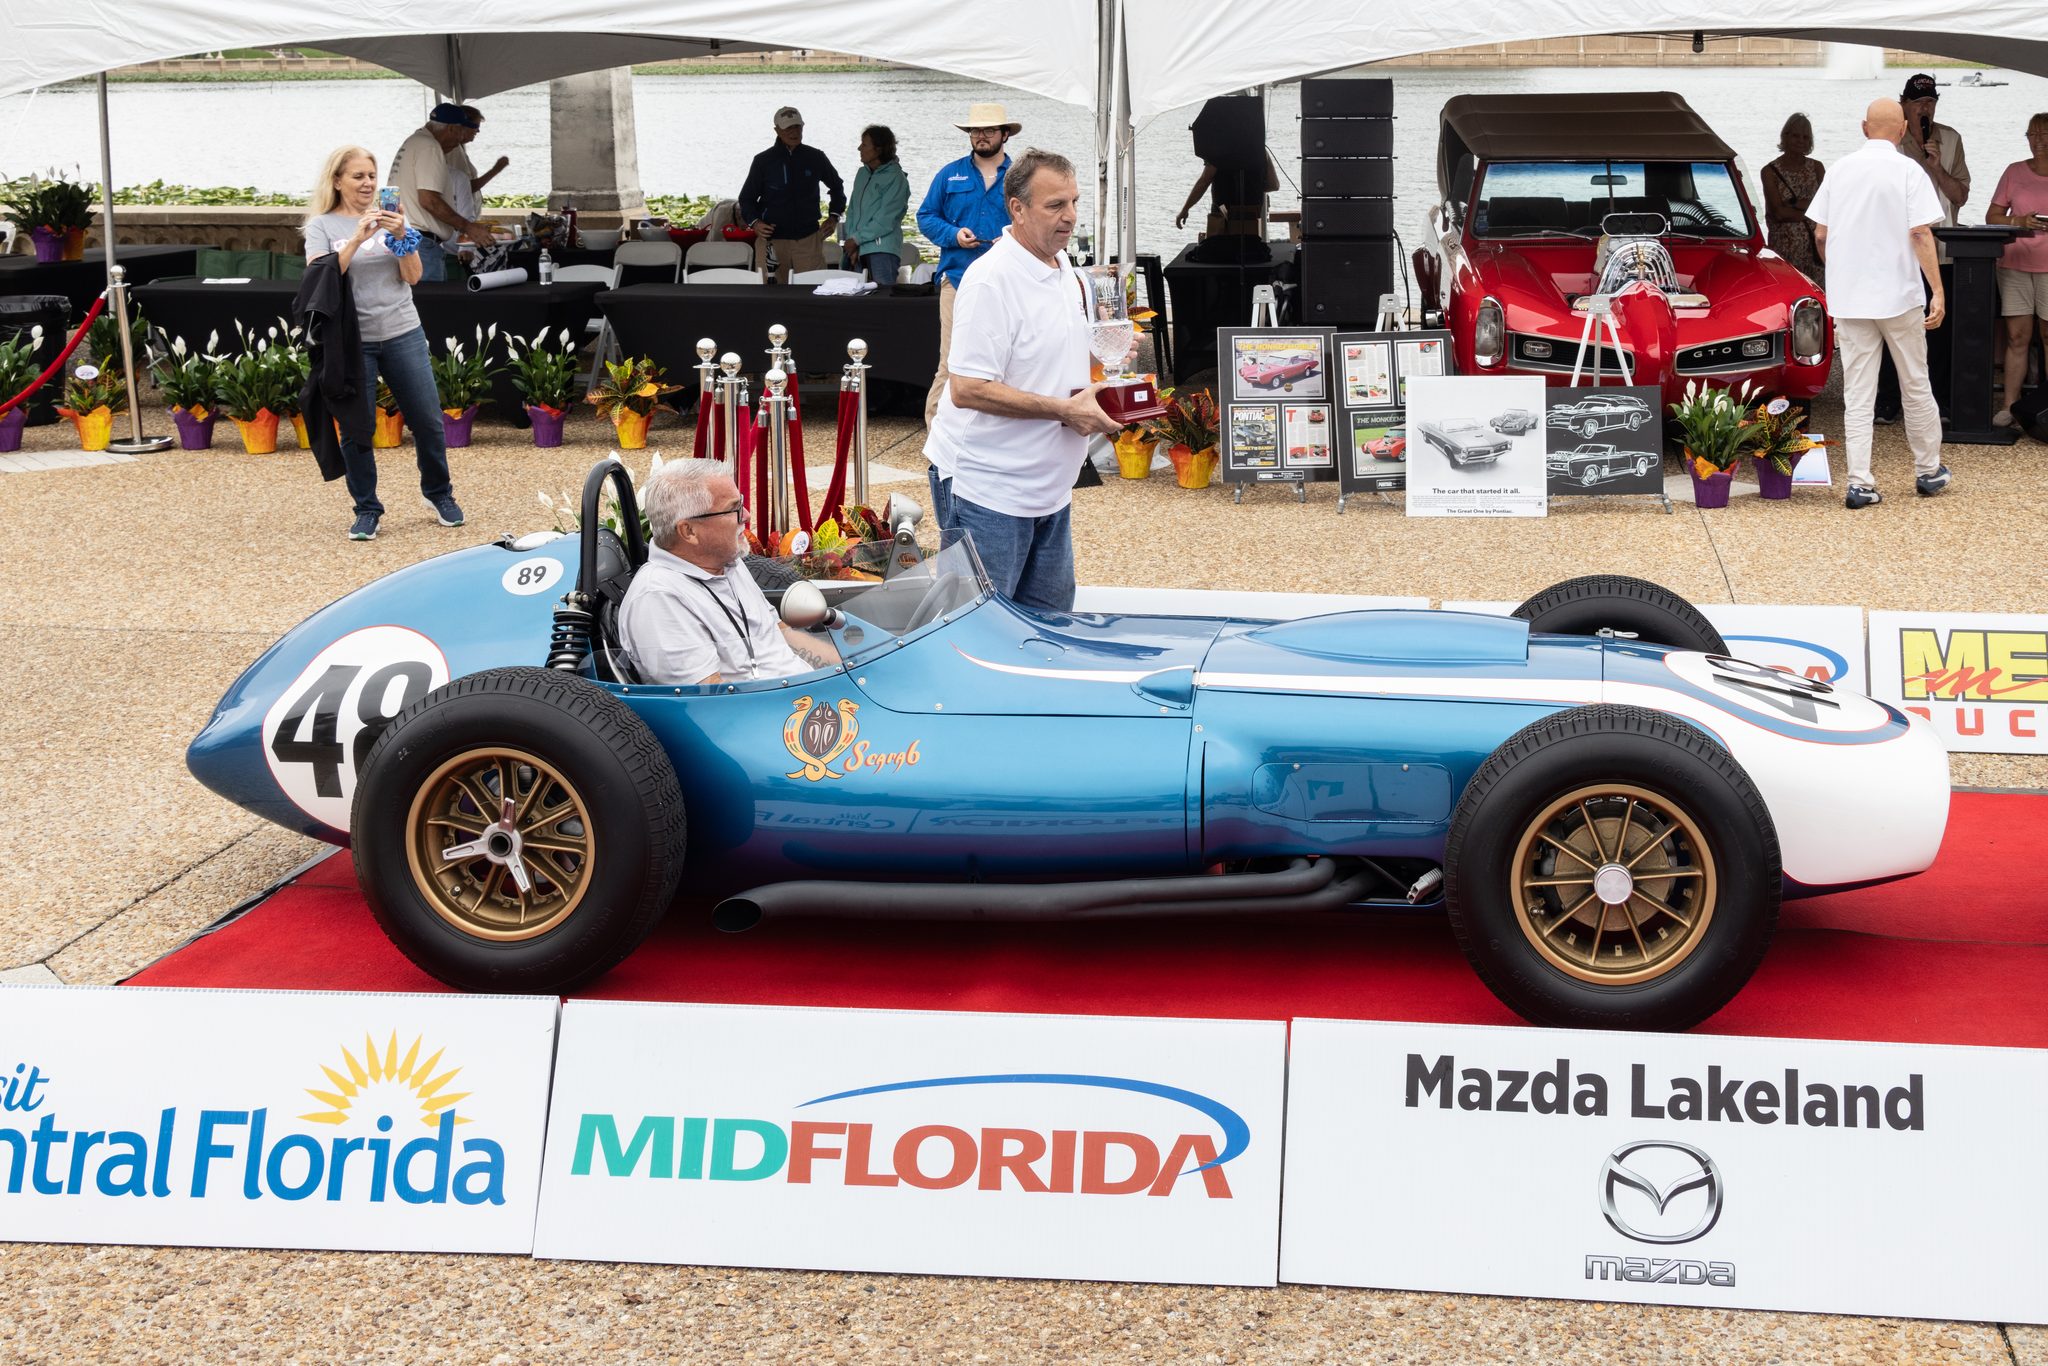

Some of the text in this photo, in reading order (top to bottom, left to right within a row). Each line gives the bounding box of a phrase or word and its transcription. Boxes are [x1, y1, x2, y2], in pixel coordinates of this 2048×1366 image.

[1693, 347, 1732, 358] GTO
[1233, 411, 1265, 421] PONTIAC
[517, 566, 547, 586] 89
[1904, 706, 2037, 738] UC
[843, 740, 921, 775] Scarab
[1405, 1053, 1925, 1131] Mazda Lakeland
[0, 1107, 506, 1206] ntral Florida
[571, 1113, 1234, 1200] MIDFLORIDA
